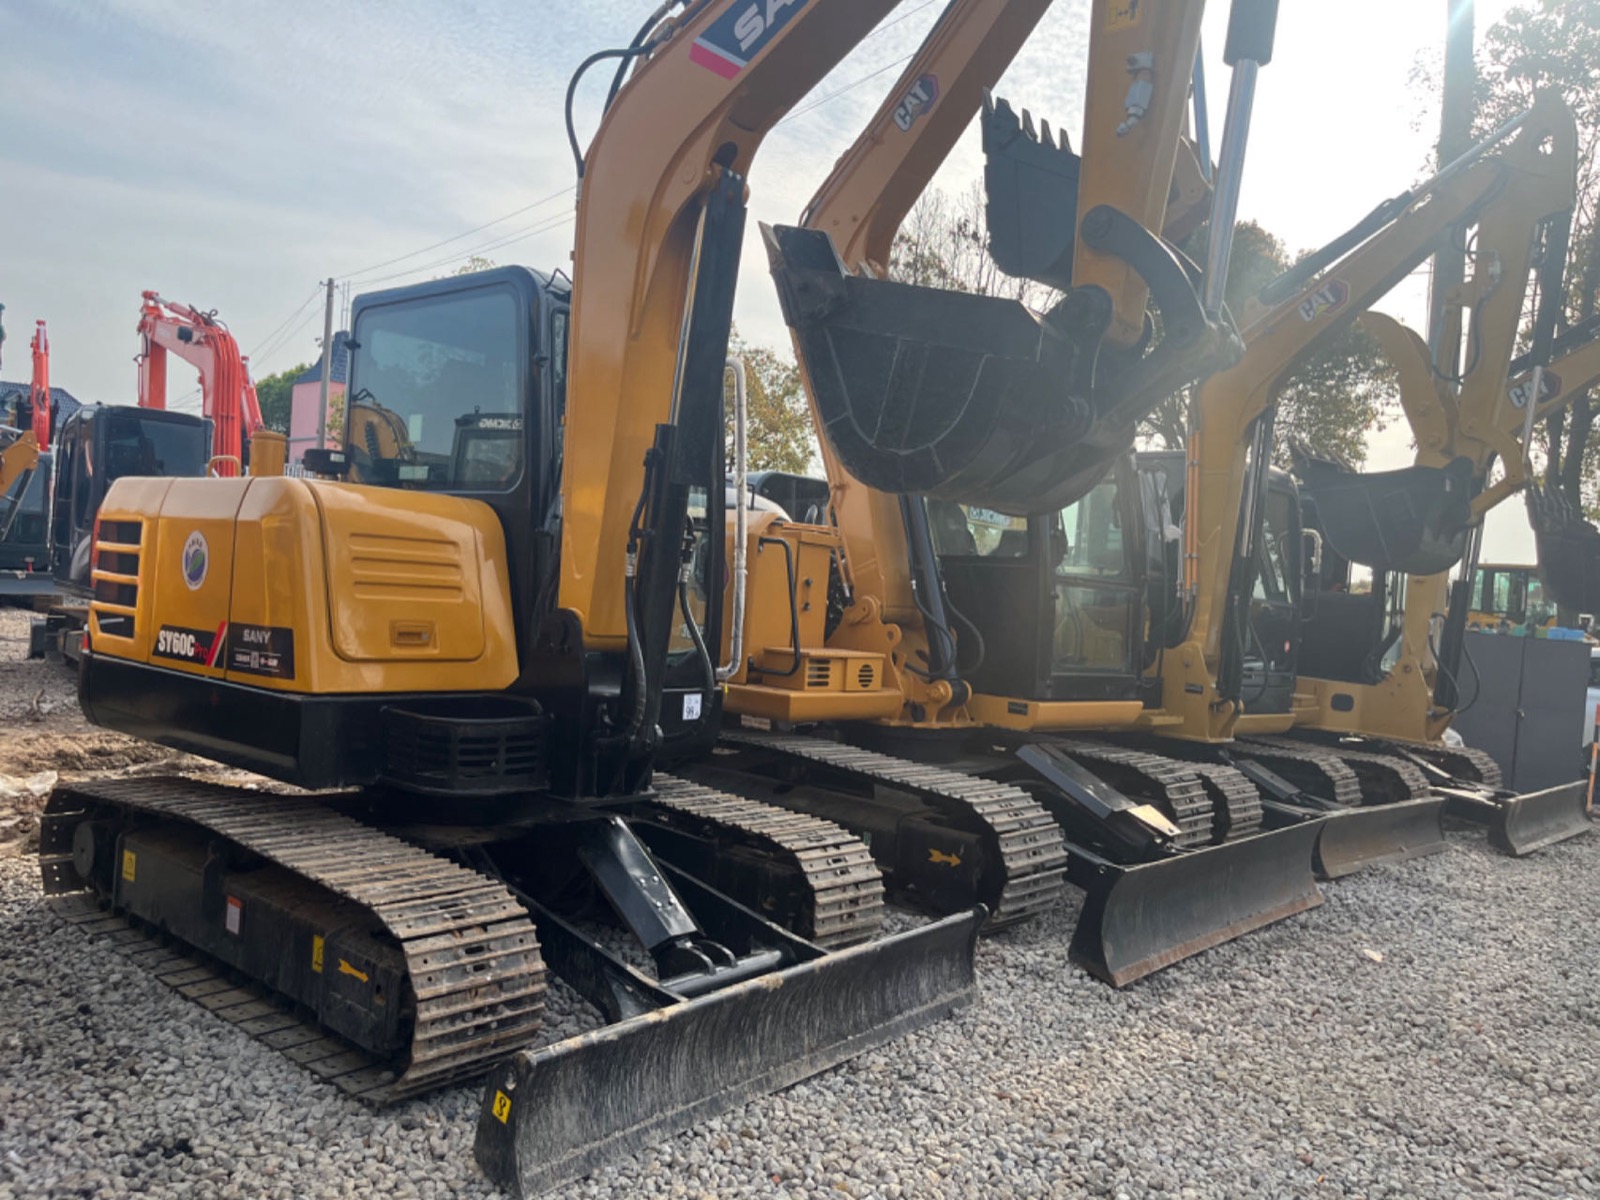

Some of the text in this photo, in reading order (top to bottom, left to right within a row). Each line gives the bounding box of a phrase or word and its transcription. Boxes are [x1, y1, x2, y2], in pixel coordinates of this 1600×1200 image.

[894, 80, 929, 131] CAT
[1298, 284, 1337, 321] CAT
[158, 630, 195, 657] SY60C
[243, 629, 271, 644] SANY
